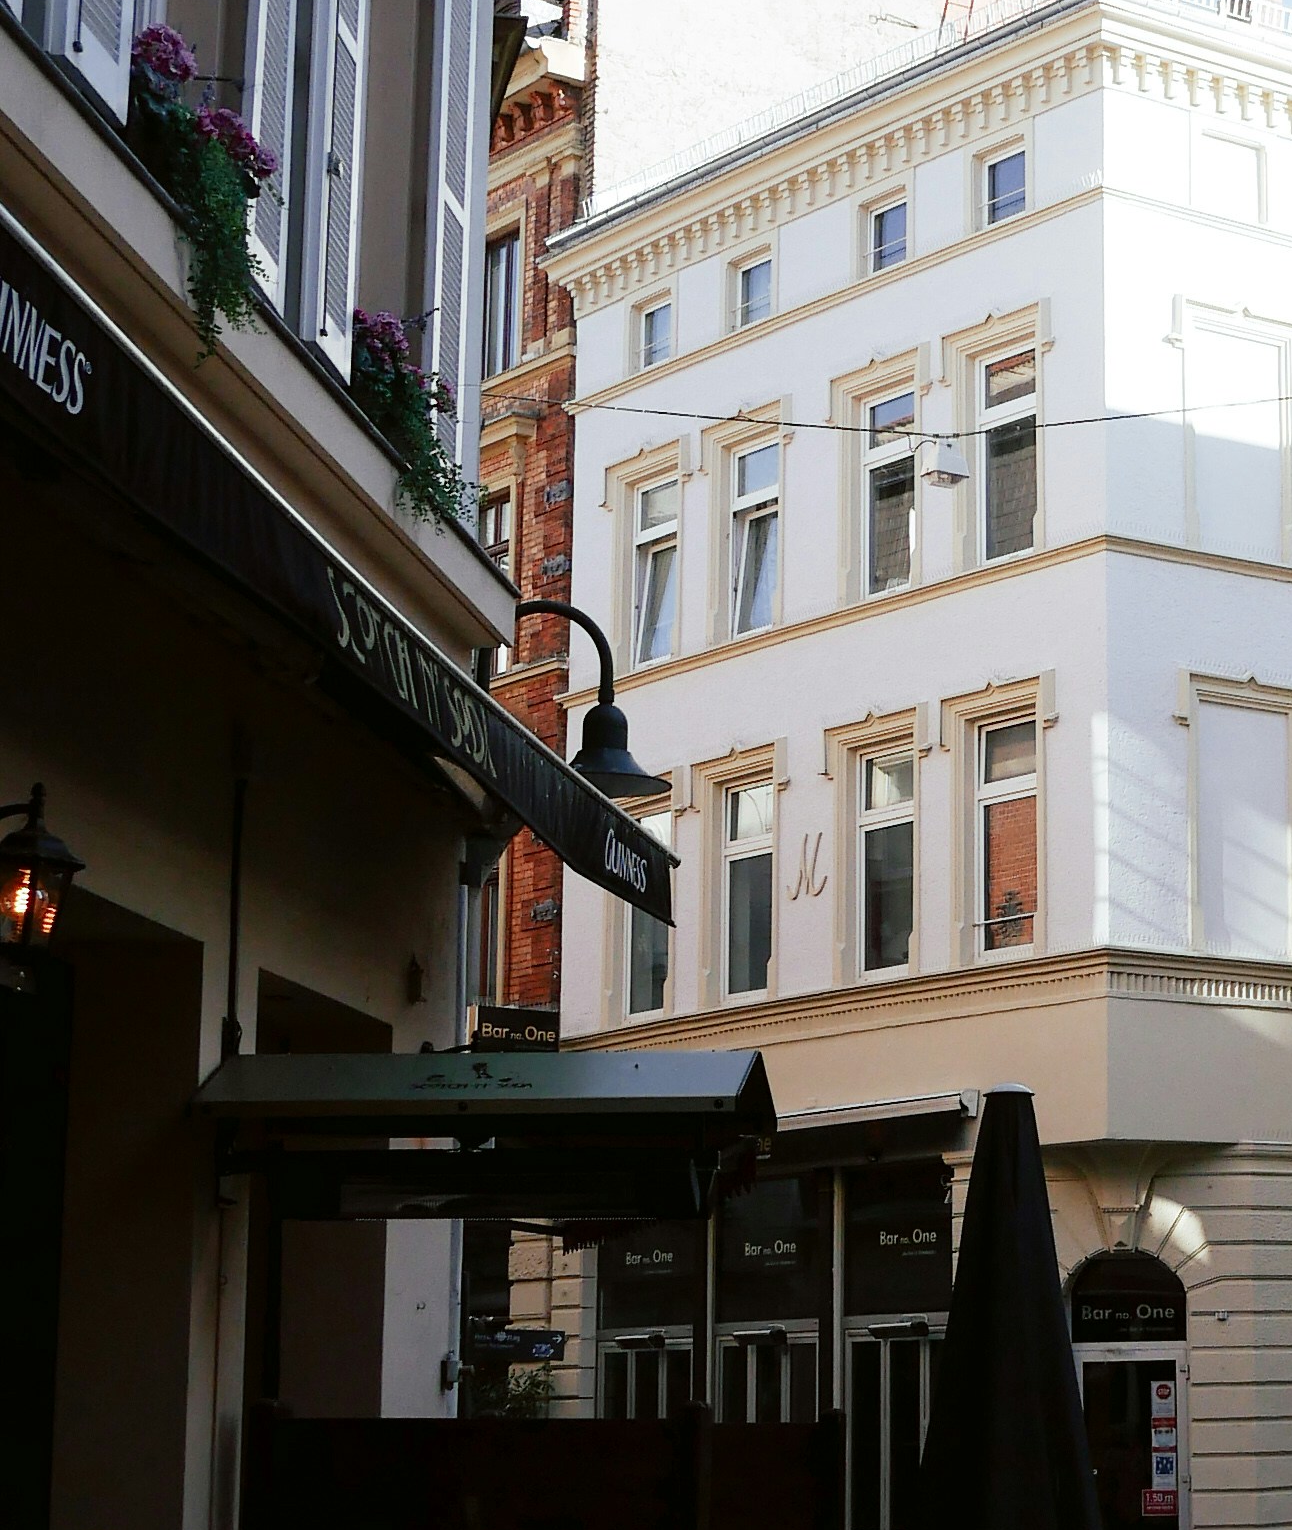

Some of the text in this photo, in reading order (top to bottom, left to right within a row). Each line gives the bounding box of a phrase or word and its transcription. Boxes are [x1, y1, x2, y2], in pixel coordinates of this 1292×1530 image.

[604, 828, 648, 894] GUINNESS
[481, 1022, 510, 1040] Bar
[525, 1025, 557, 1042] One
[879, 1231, 899, 1246] Bar
[912, 1229, 937, 1244] One
[625, 1252, 643, 1265] Bar
[653, 1249, 674, 1263] One
[745, 1242, 763, 1257] Bar
[774, 1240, 797, 1254] One
[1081, 1305, 1113, 1320] Bar
[1136, 1304, 1175, 1319] One
